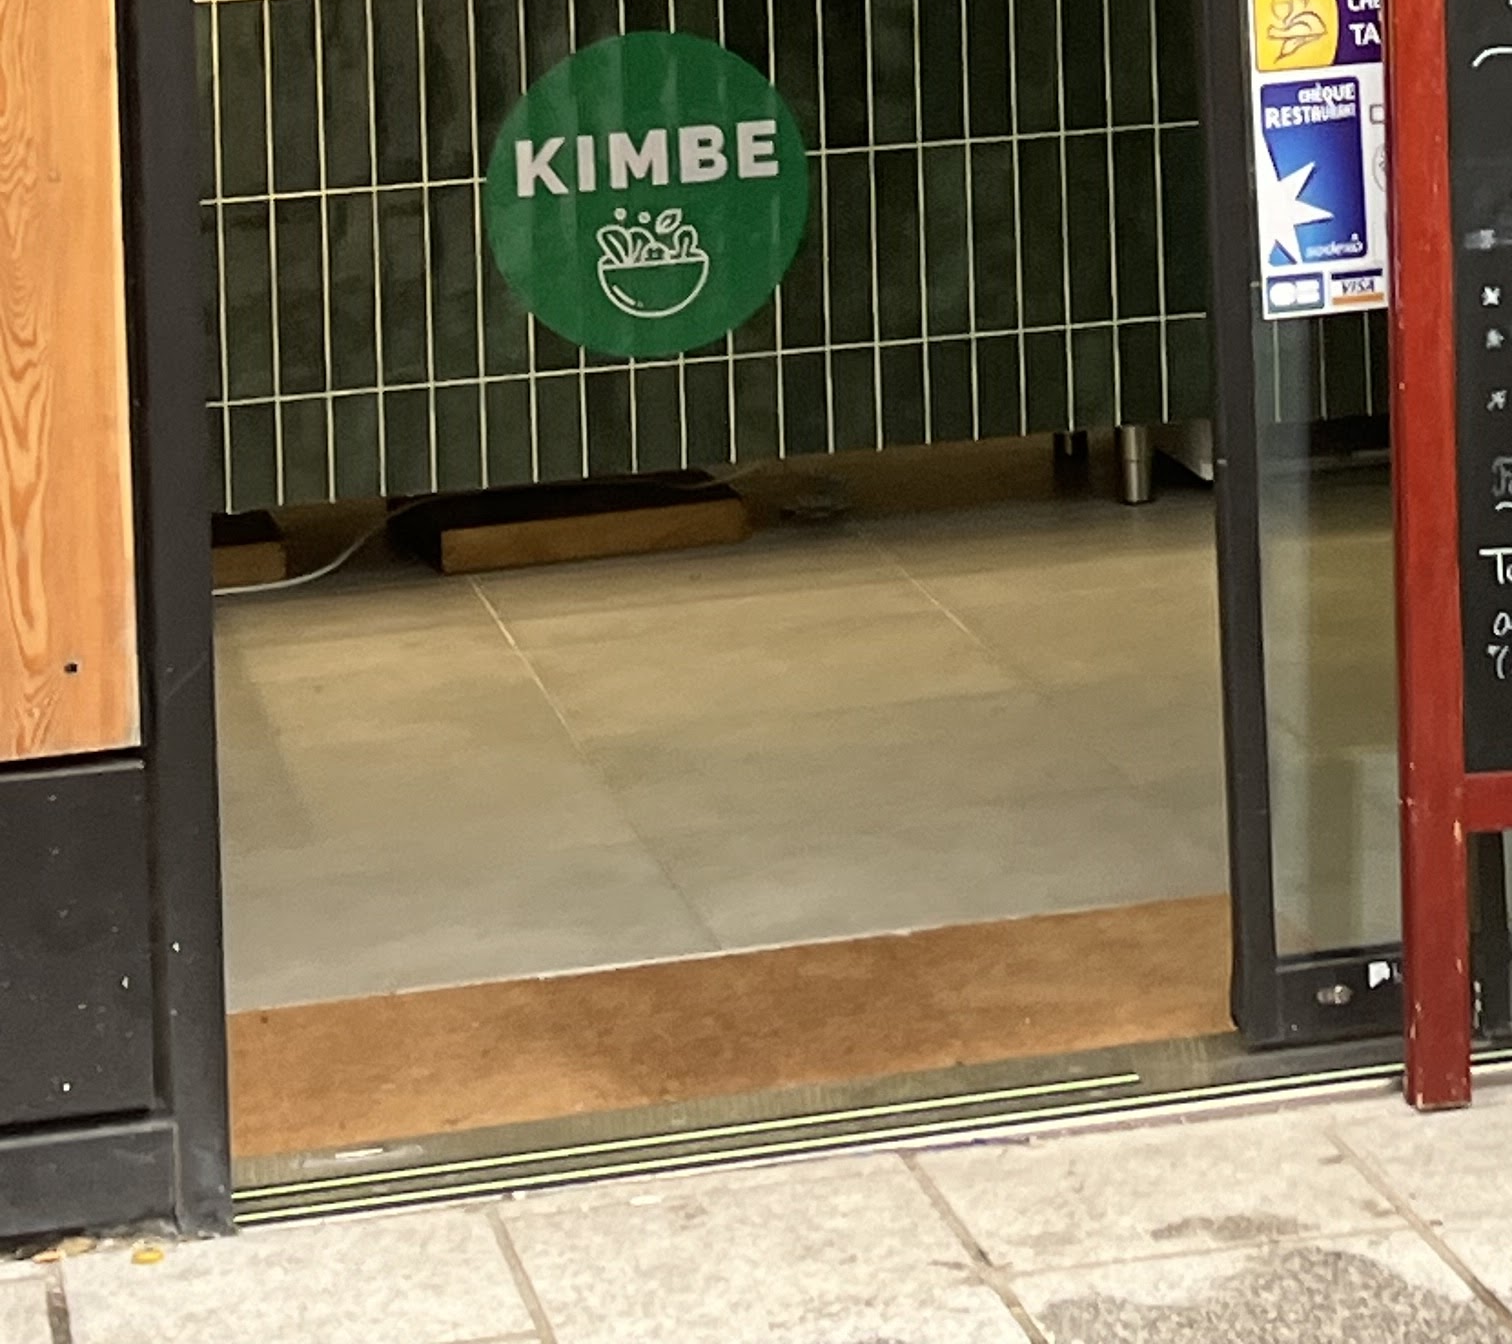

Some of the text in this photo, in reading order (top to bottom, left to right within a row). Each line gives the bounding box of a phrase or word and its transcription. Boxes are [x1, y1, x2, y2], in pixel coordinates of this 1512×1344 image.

[1298, 81, 1356, 105] CHÈQUE
[514, 119, 781, 198] KIMBE
[1341, 278, 1376, 295] VISA
